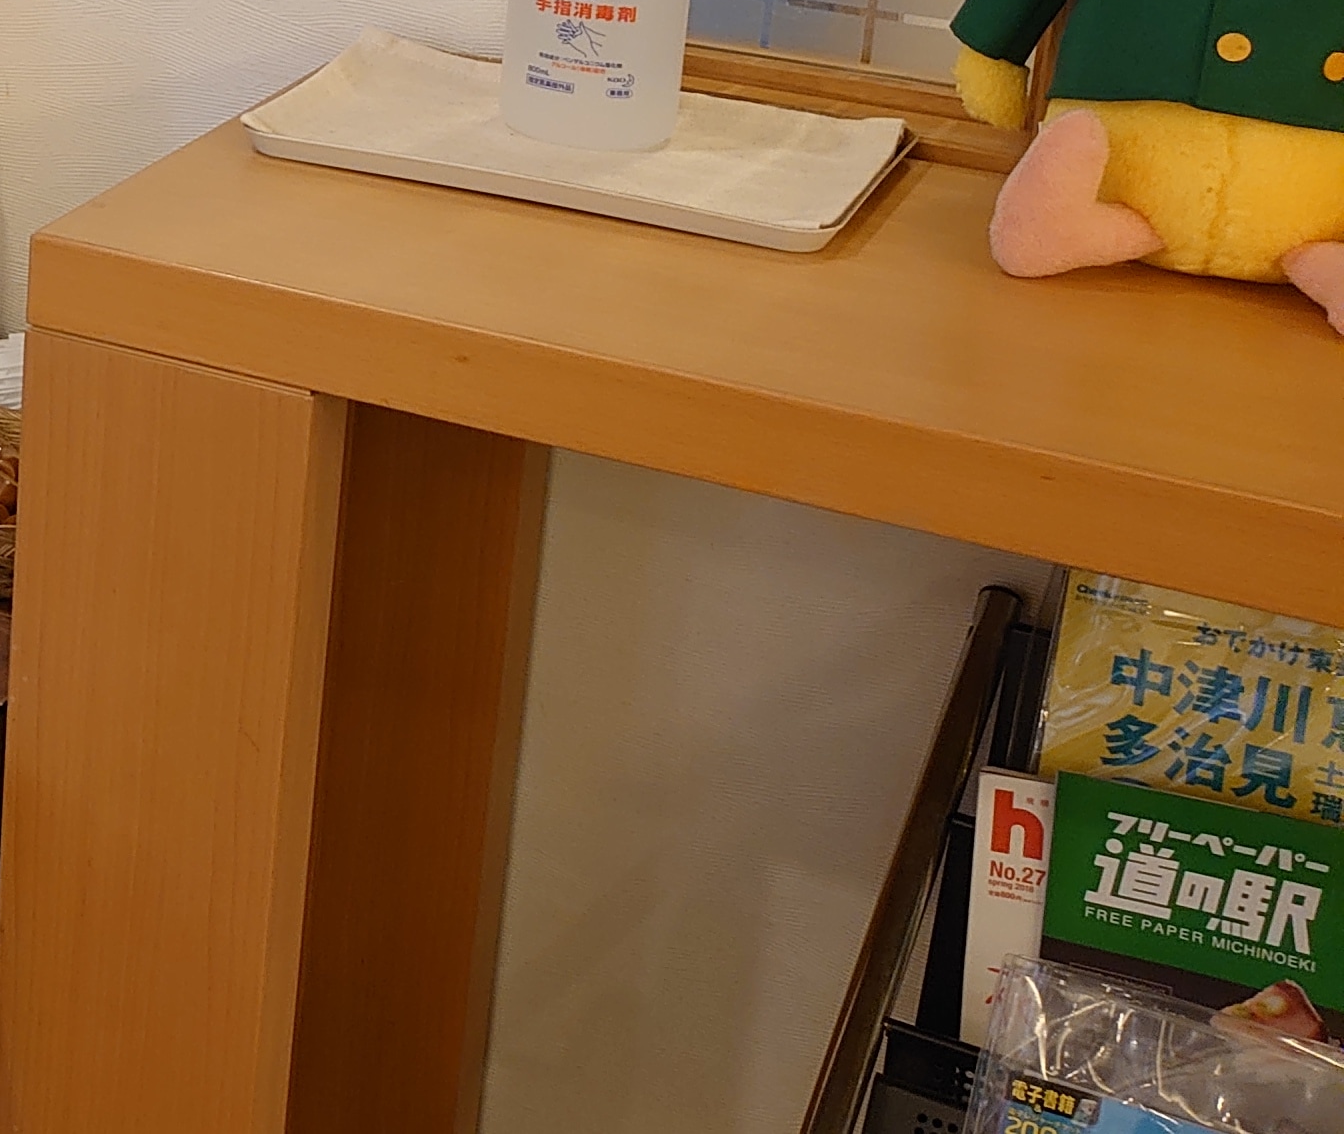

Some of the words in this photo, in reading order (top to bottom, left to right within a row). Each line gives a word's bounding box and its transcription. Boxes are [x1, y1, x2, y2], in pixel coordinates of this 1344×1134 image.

[1110, 648, 1313, 745] 中津川
[1100, 713, 1298, 809] 多治見
[990, 788, 1045, 861] h
[1107, 811, 1331, 874] フリーペーパー
[989, 860, 1046, 886] No.27
[1083, 837, 1323, 956] 道の駅
[1084, 905, 1134, 928] FREE
[1140, 918, 1204, 945] PAPER
[1211, 936, 1316, 973] MICHINOEKI
